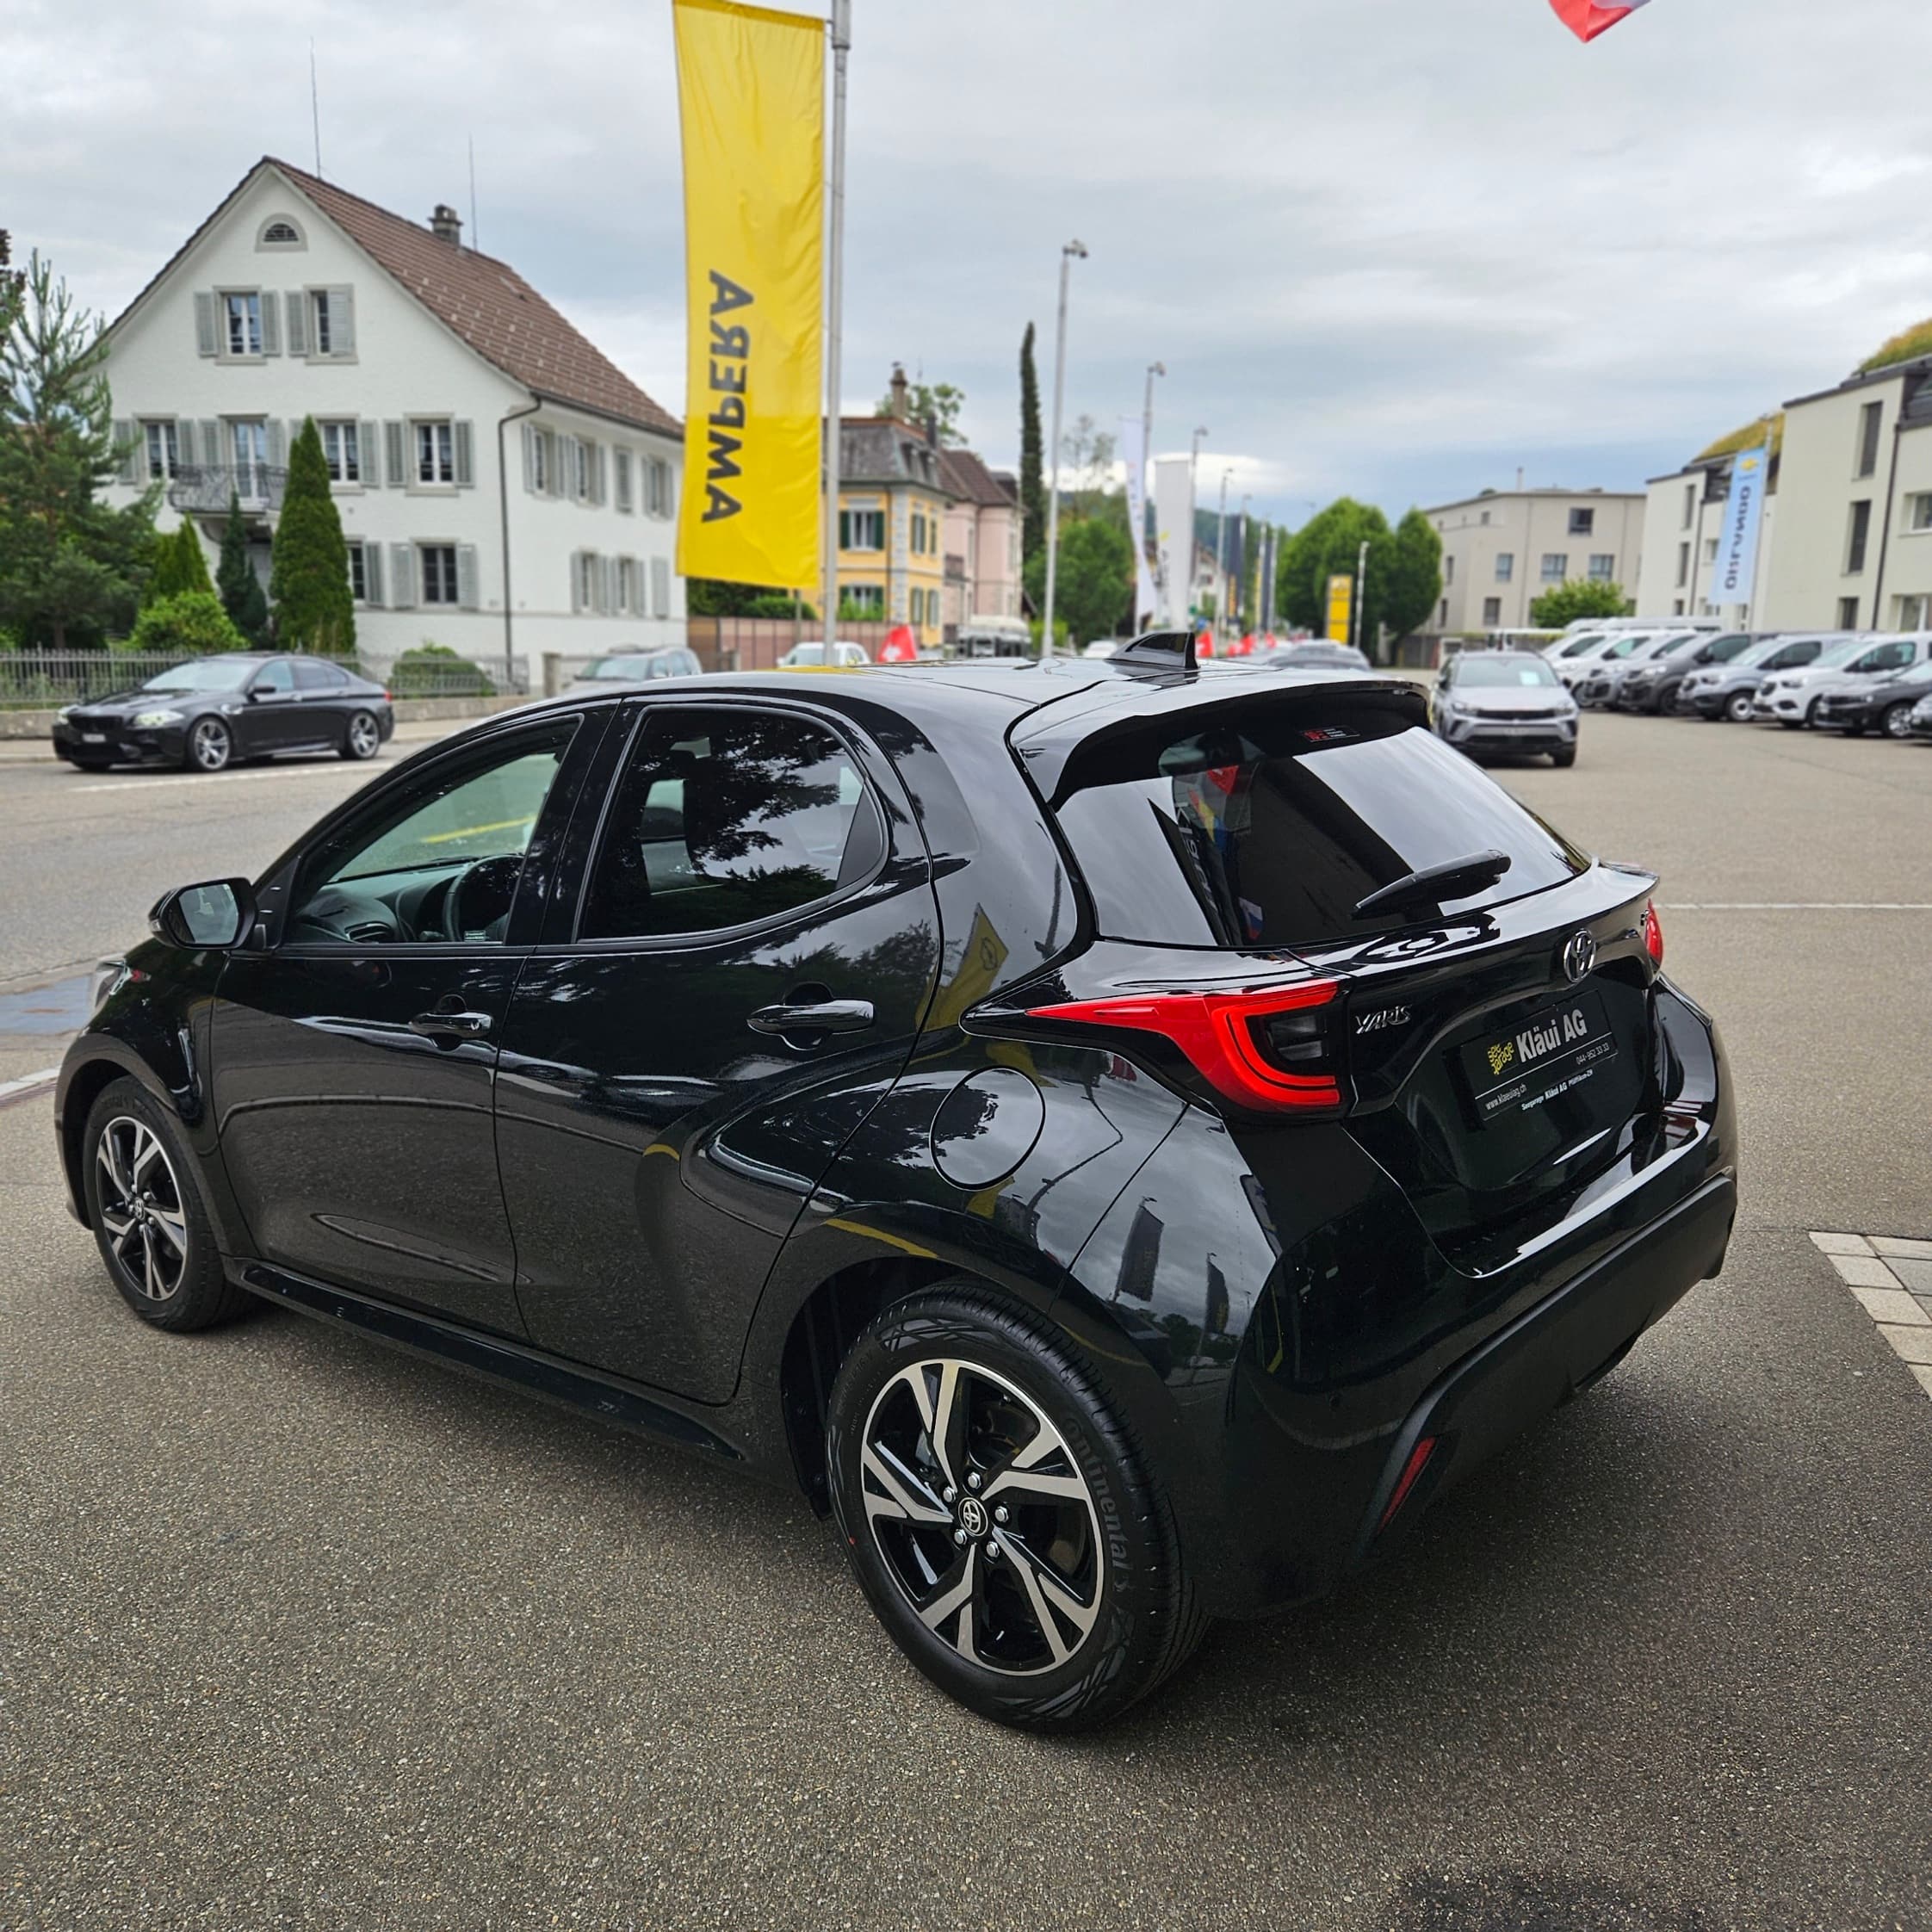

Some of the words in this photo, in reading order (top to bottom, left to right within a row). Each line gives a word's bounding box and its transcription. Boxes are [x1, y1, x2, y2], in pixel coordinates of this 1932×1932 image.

[1355, 1005, 1412, 1034] YARIS
[1515, 1019, 1561, 1062] Kläui
[1563, 1009, 1588, 1043] AG
[1558, 1081, 1568, 1093] AG
[1062, 1416, 1131, 1570] Continental
